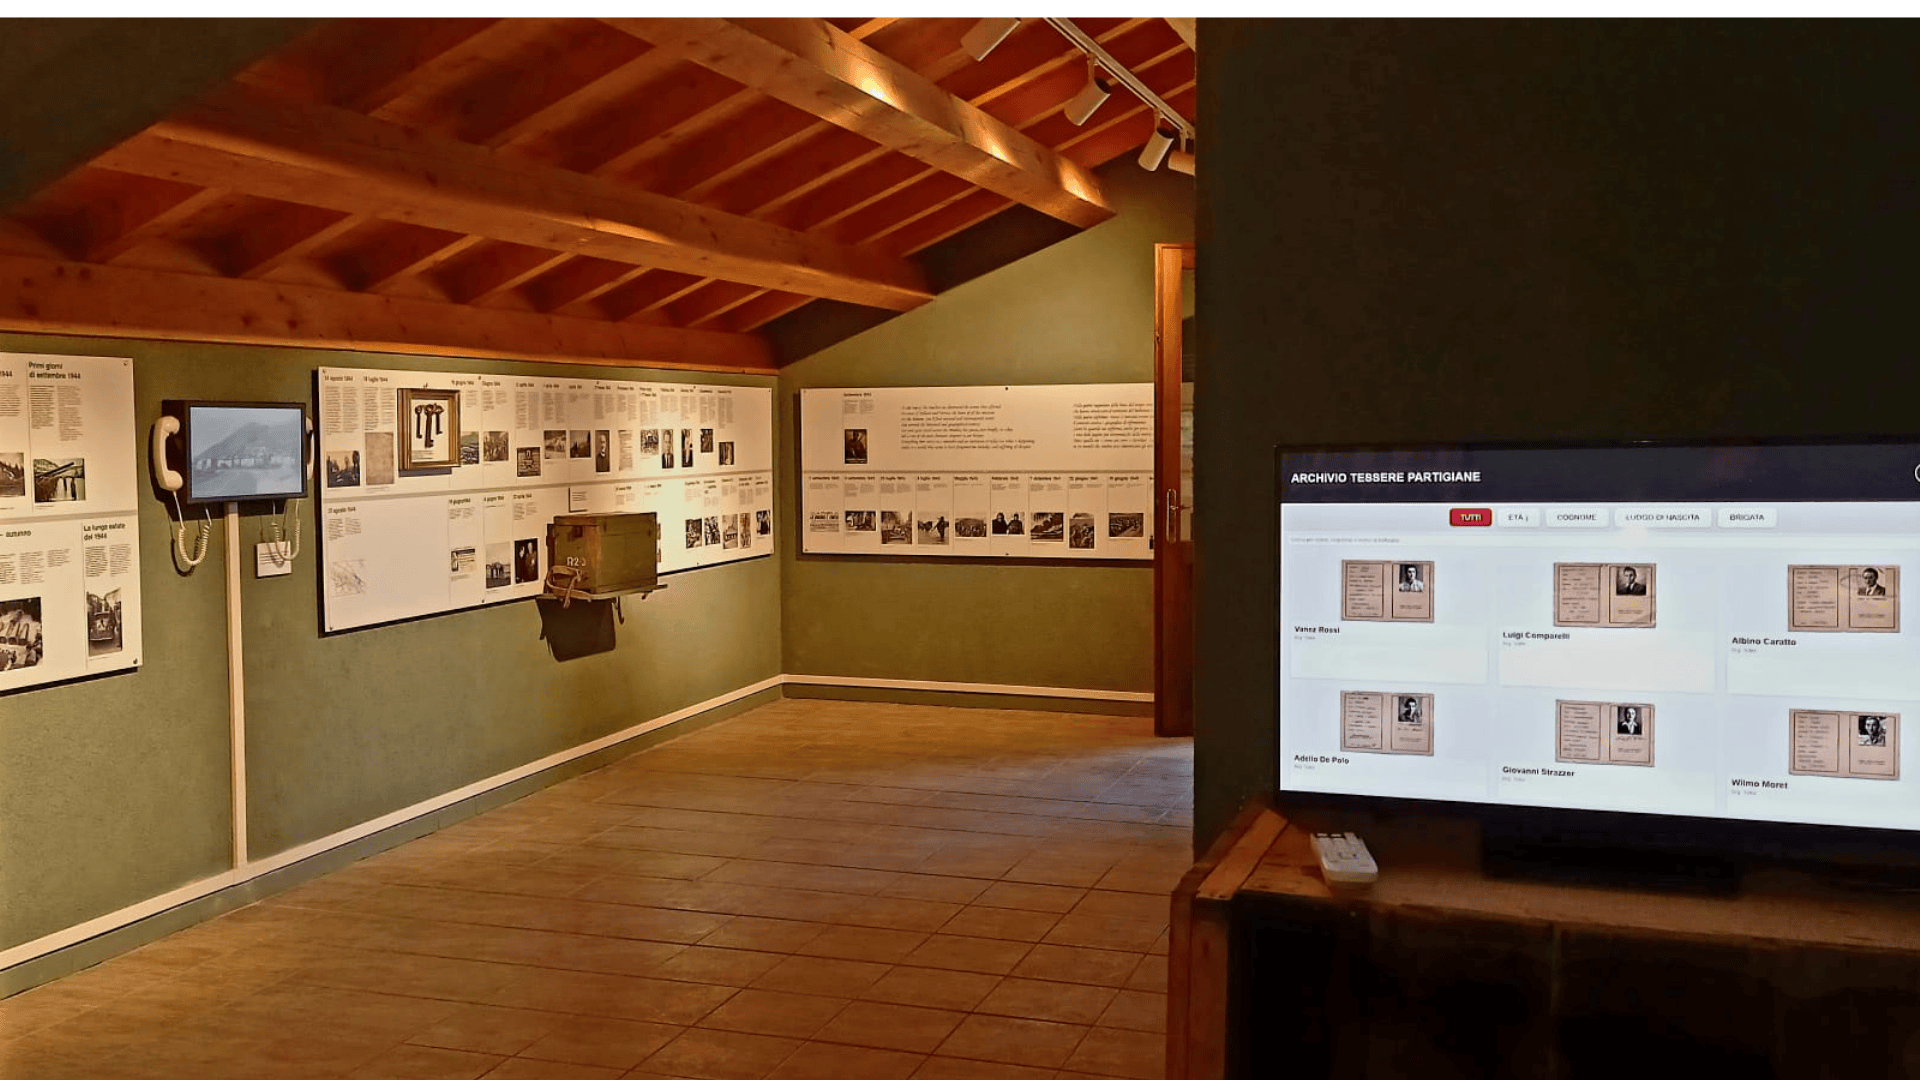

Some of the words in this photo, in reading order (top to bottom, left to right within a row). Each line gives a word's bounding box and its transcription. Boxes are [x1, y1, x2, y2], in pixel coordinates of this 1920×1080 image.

[1290, 472, 1347, 484] ARCHIVIO
[1350, 472, 1405, 483] TESSERE
[1407, 471, 1482, 483] PARTIGIANE
[1460, 513, 1483, 521] TUTTI
[1557, 513, 1597, 521] COGNOME
[1666, 513, 1700, 521] NASCITA
[1729, 513, 1765, 521] BRIGATA
[1318, 626, 1340, 634] Rossi
[1502, 631, 1524, 640] Luigi
[1731, 637, 1761, 645] Albino
[1762, 638, 1797, 646] Caratto
[1319, 755, 1330, 763] De
[1331, 756, 1350, 765] Polo
[1502, 765, 1539, 775] Giovanni
[1541, 768, 1575, 777] Strazzer
[1731, 779, 1760, 787] Wilmo
[1761, 780, 1788, 789] Moret
